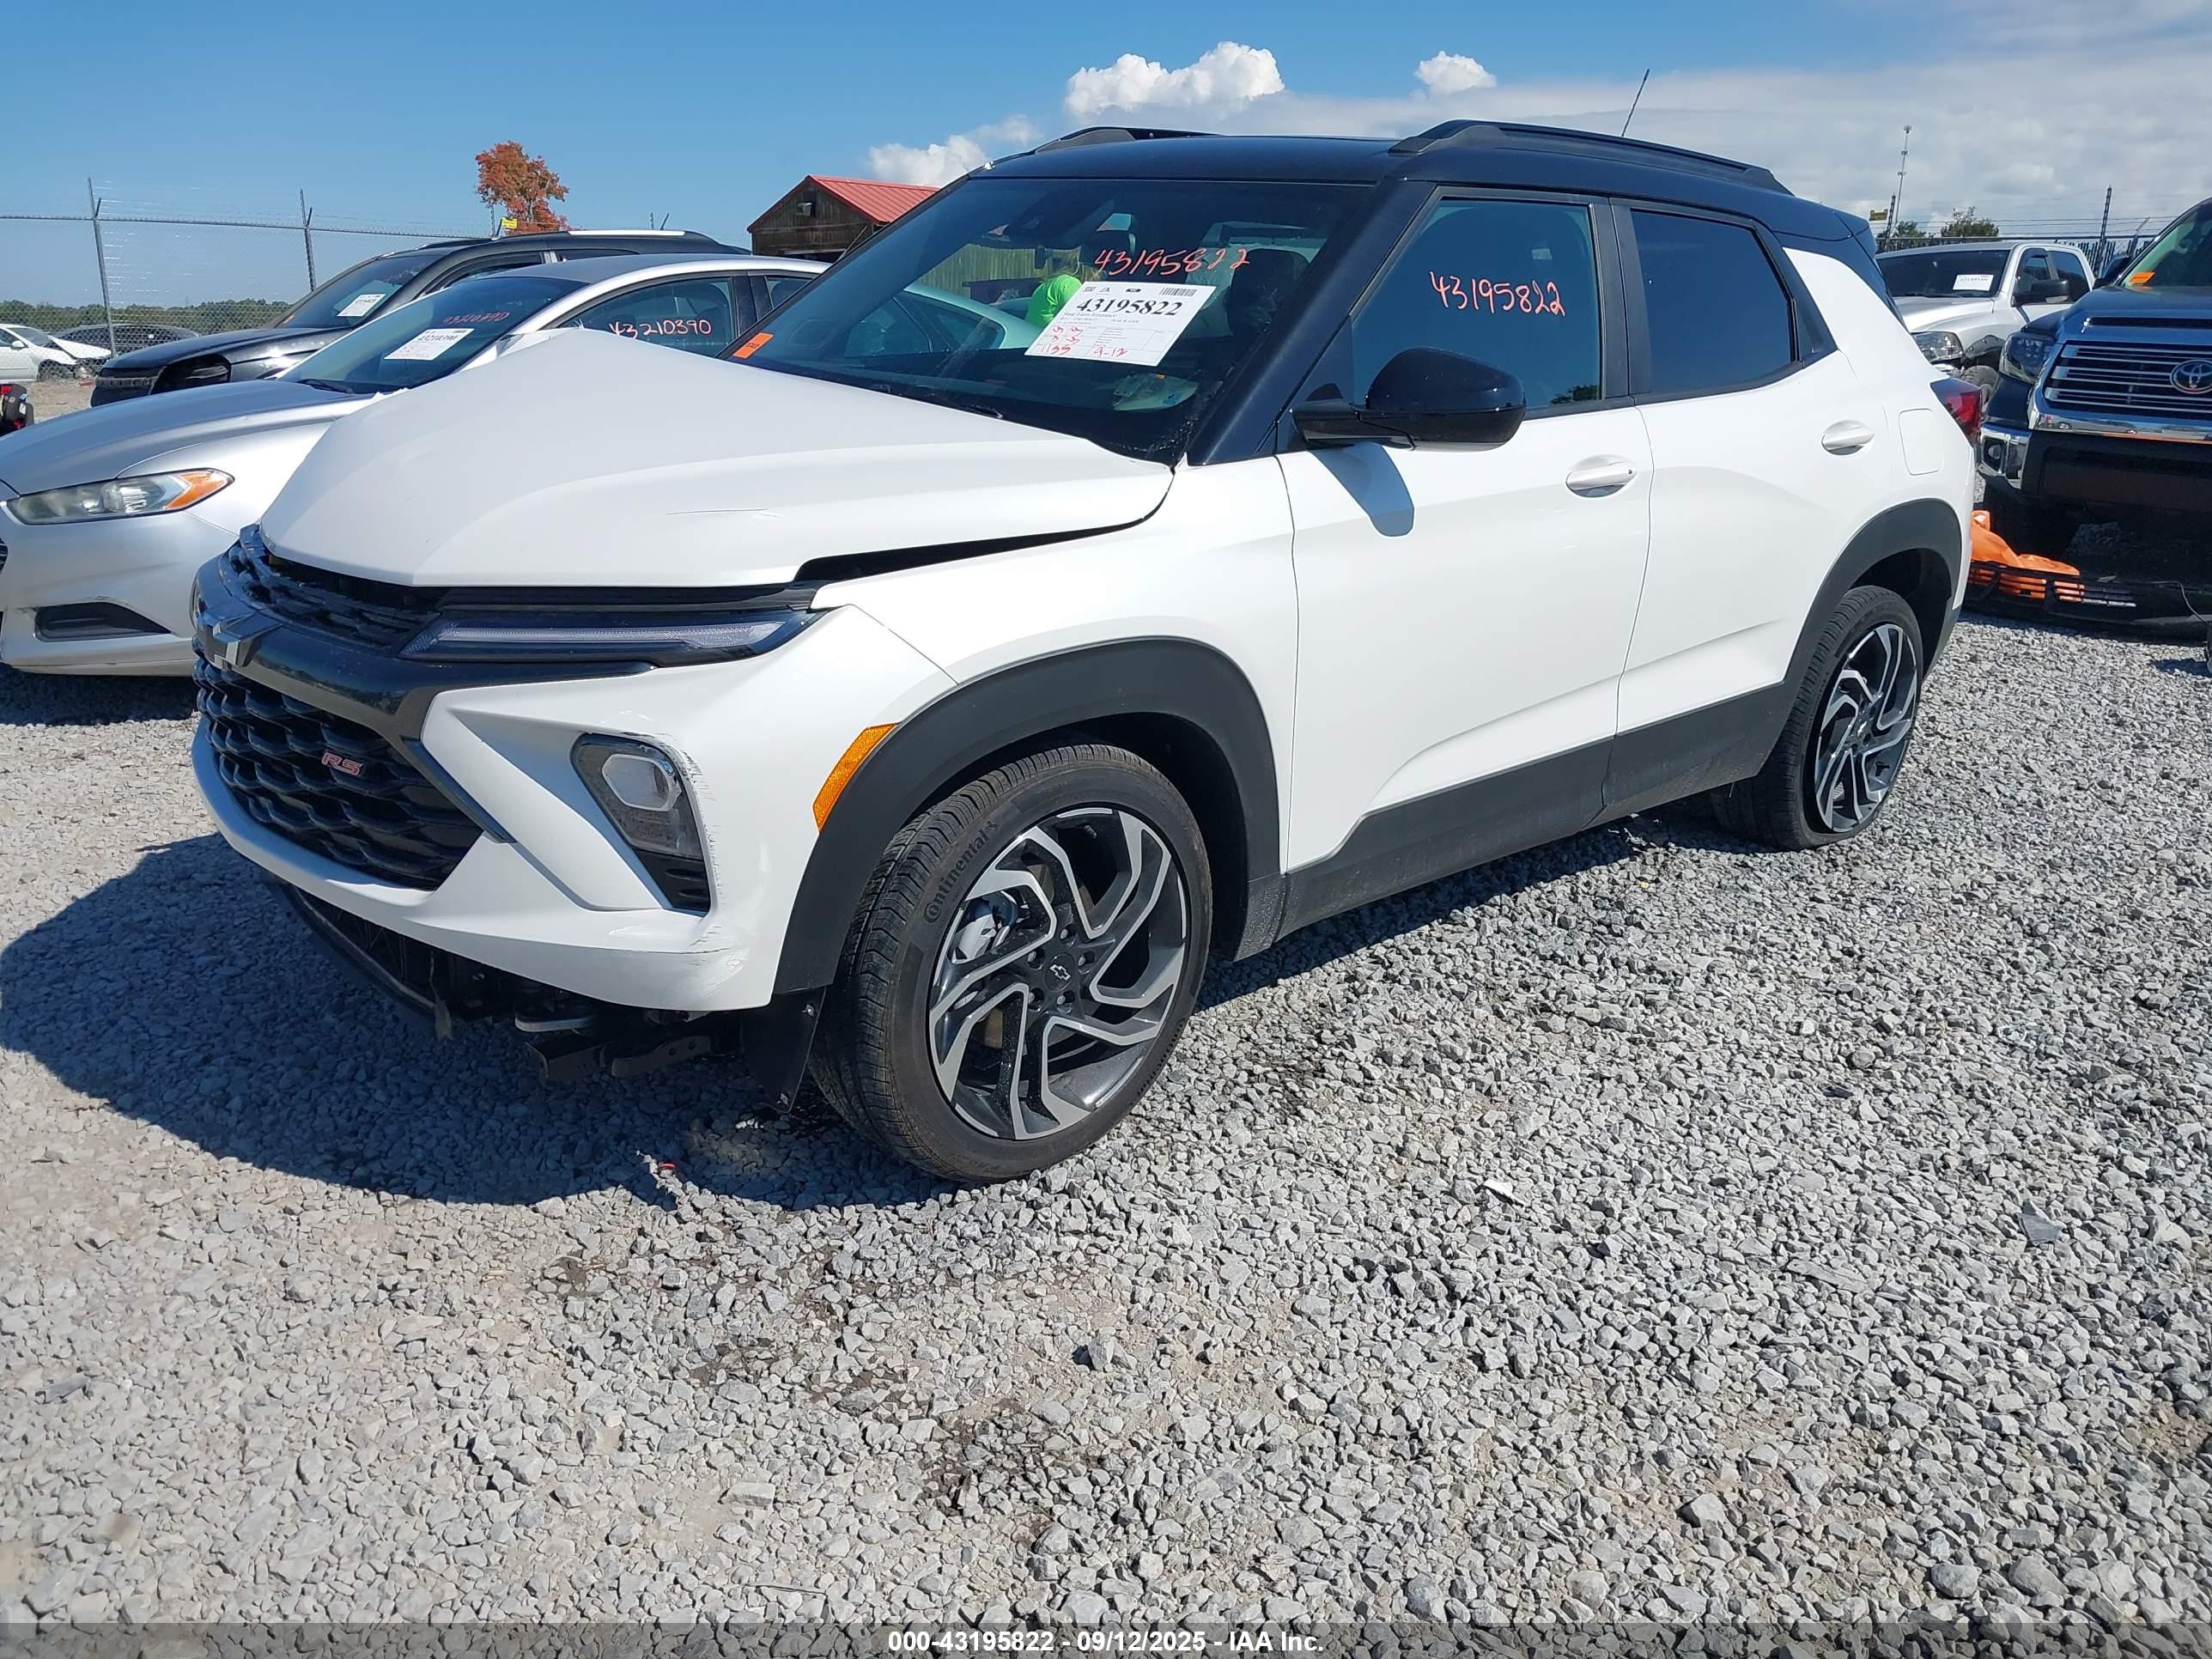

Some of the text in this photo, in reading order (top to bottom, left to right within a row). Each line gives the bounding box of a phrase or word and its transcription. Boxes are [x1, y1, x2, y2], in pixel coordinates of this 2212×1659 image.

[1094, 247, 1250, 276] 43195822
[1076, 299, 1182, 316] 43195822
[1429, 270, 1565, 317] 43195822
[321, 752, 364, 776] RS
[923, 828, 990, 923] Continental
